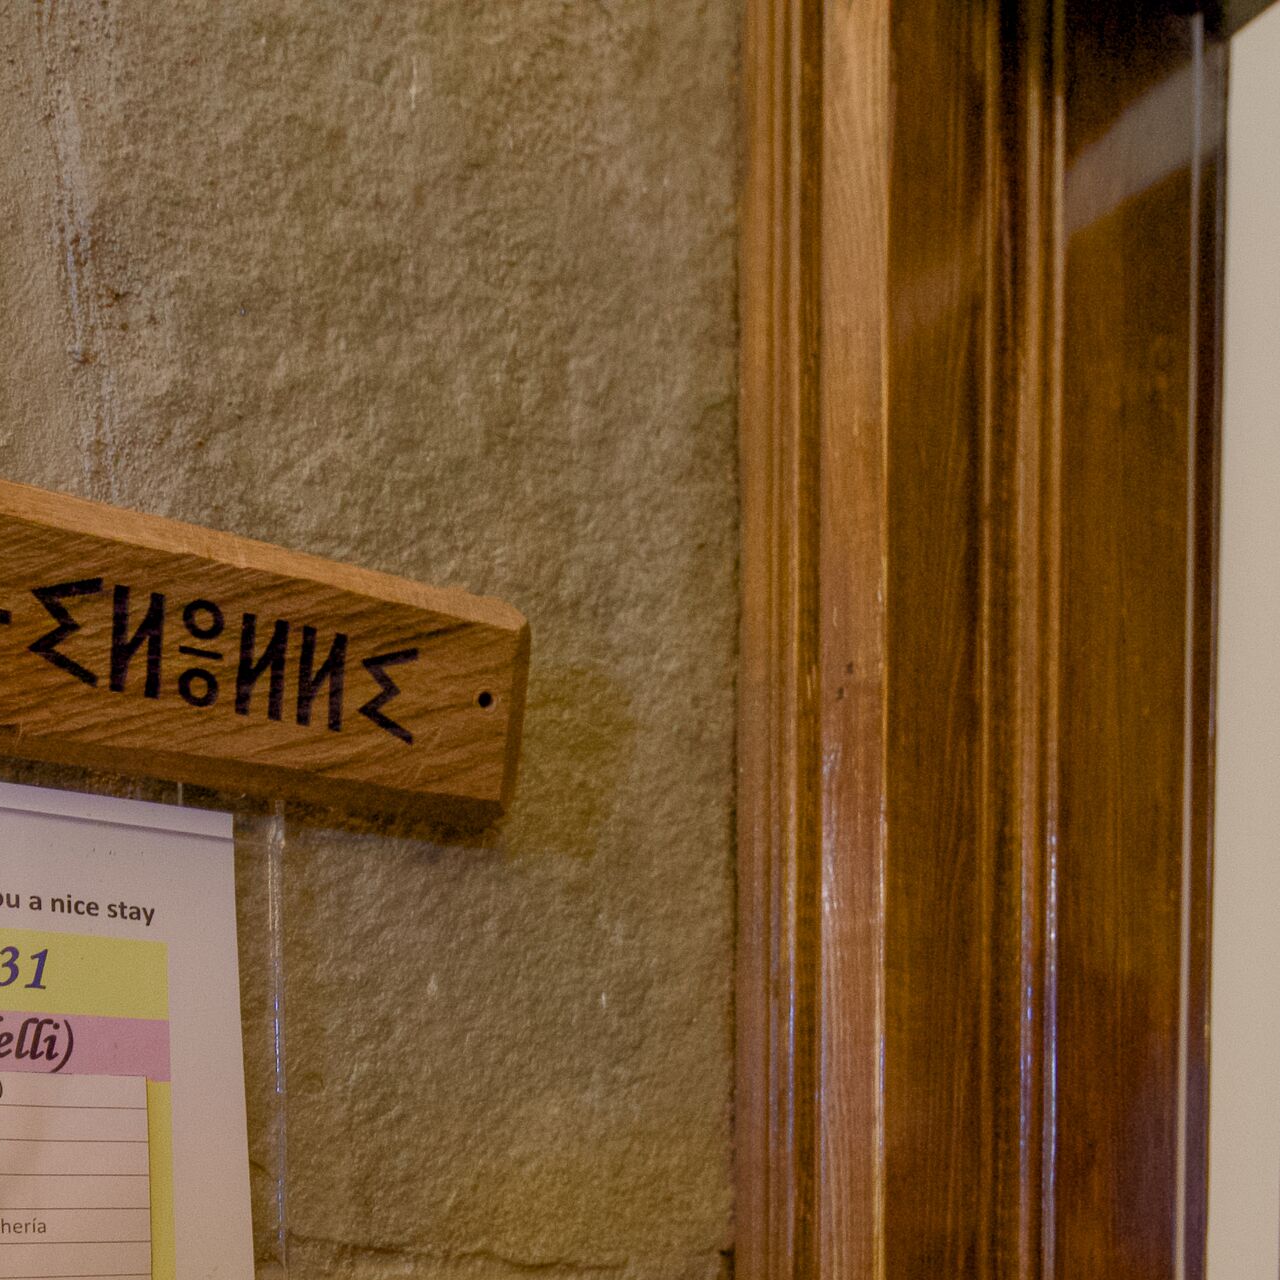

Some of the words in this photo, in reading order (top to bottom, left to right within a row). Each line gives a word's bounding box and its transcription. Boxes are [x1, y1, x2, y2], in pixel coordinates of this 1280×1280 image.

[29, 896, 42, 911] a
[51, 894, 99, 917] nice
[107, 901, 155, 926] stay
